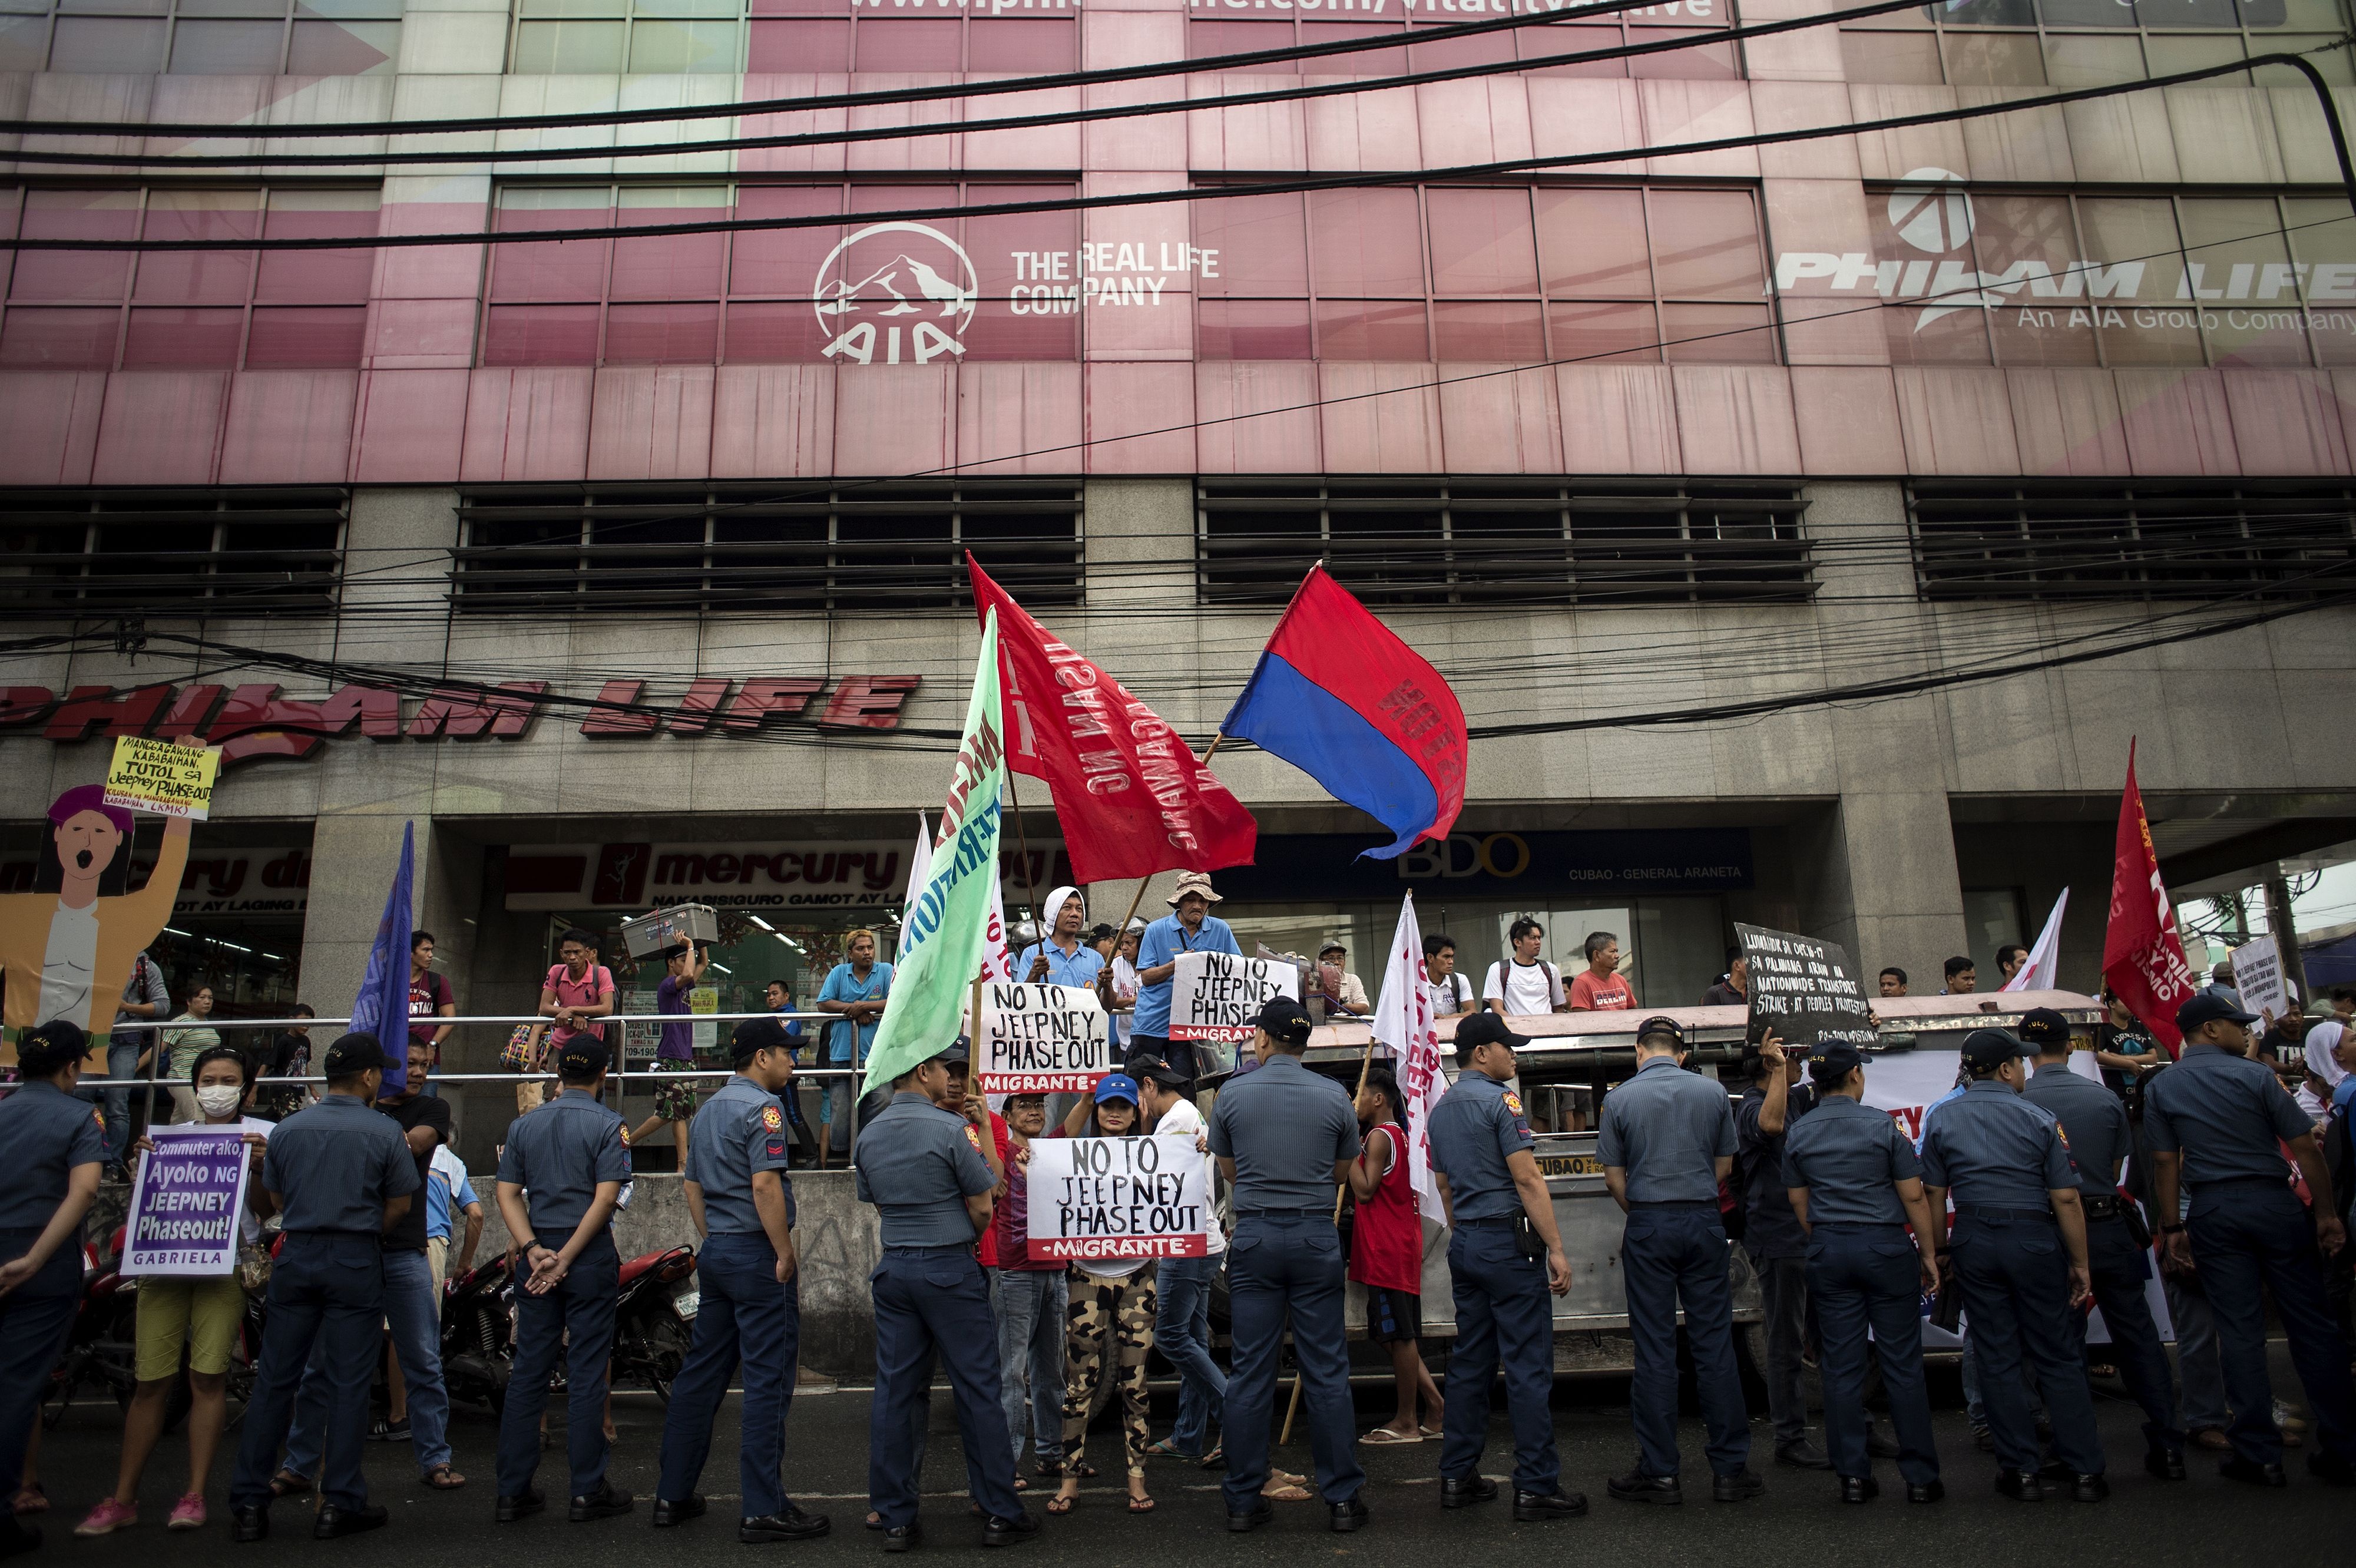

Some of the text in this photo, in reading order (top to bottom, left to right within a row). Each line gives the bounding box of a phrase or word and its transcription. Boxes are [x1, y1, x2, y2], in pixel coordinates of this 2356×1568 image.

[1011, 242, 1220, 281] THE REAL LIFE
[2176, 263, 2356, 299] LIFE
[1011, 276, 1167, 316] COMPANY
[2017, 304, 2356, 336] An AIA Group Company
[820, 321, 967, 365] AIA
[580, 674, 923, 737] LIFE
[123, 737, 205, 759] MANGGAGAWANG
[133, 750, 199, 769] KABABAIHAN,
[125, 762, 177, 780] TUTOL
[105, 788, 133, 799] KILUSAN
[1398, 832, 1530, 879] BDO
[653, 851, 899, 890] mercury
[1569, 868, 1613, 881] CUBAO
[1623, 867, 1682, 880] GENERAL
[1683, 866, 1742, 879] ARANETA
[201, 901, 225, 911] AY
[228, 901, 294, 911] LAGING
[788, 893, 851, 906] GAMOT
[856, 894, 881, 905] AY
[1782, 940, 1792, 955] SA
[1206, 951, 1268, 981] NO TO
[1752, 955, 1763, 971] SA
[1808, 961, 1828, 978] ARAW
[1833, 965, 1844, 979] NA
[1194, 975, 1282, 1003] JEEPNEY
[1756, 975, 1857, 995] NATIONWIDE TRANSPORT
[994, 984, 1067, 1013] NO TO
[1597, 991, 1626, 1005] BERLIN
[1756, 994, 1788, 1015] STRIKE
[991, 1011, 1095, 1042] JEEPNEY
[1291, 1017, 1311, 1027] PULIS
[565, 1054, 588, 1064] PULIS
[151, 1139, 243, 1157] Commuter ako,
[1071, 1136, 1159, 1177] NO TO
[147, 1161, 237, 1189] Ayoko NG
[1057, 1172, 1185, 1207] JEEPNEY
[145, 1192, 231, 1212] JEEPNEY
[136, 1215, 230, 1240] Phaseout!
[134, 1252, 221, 1265] GABRIELA
